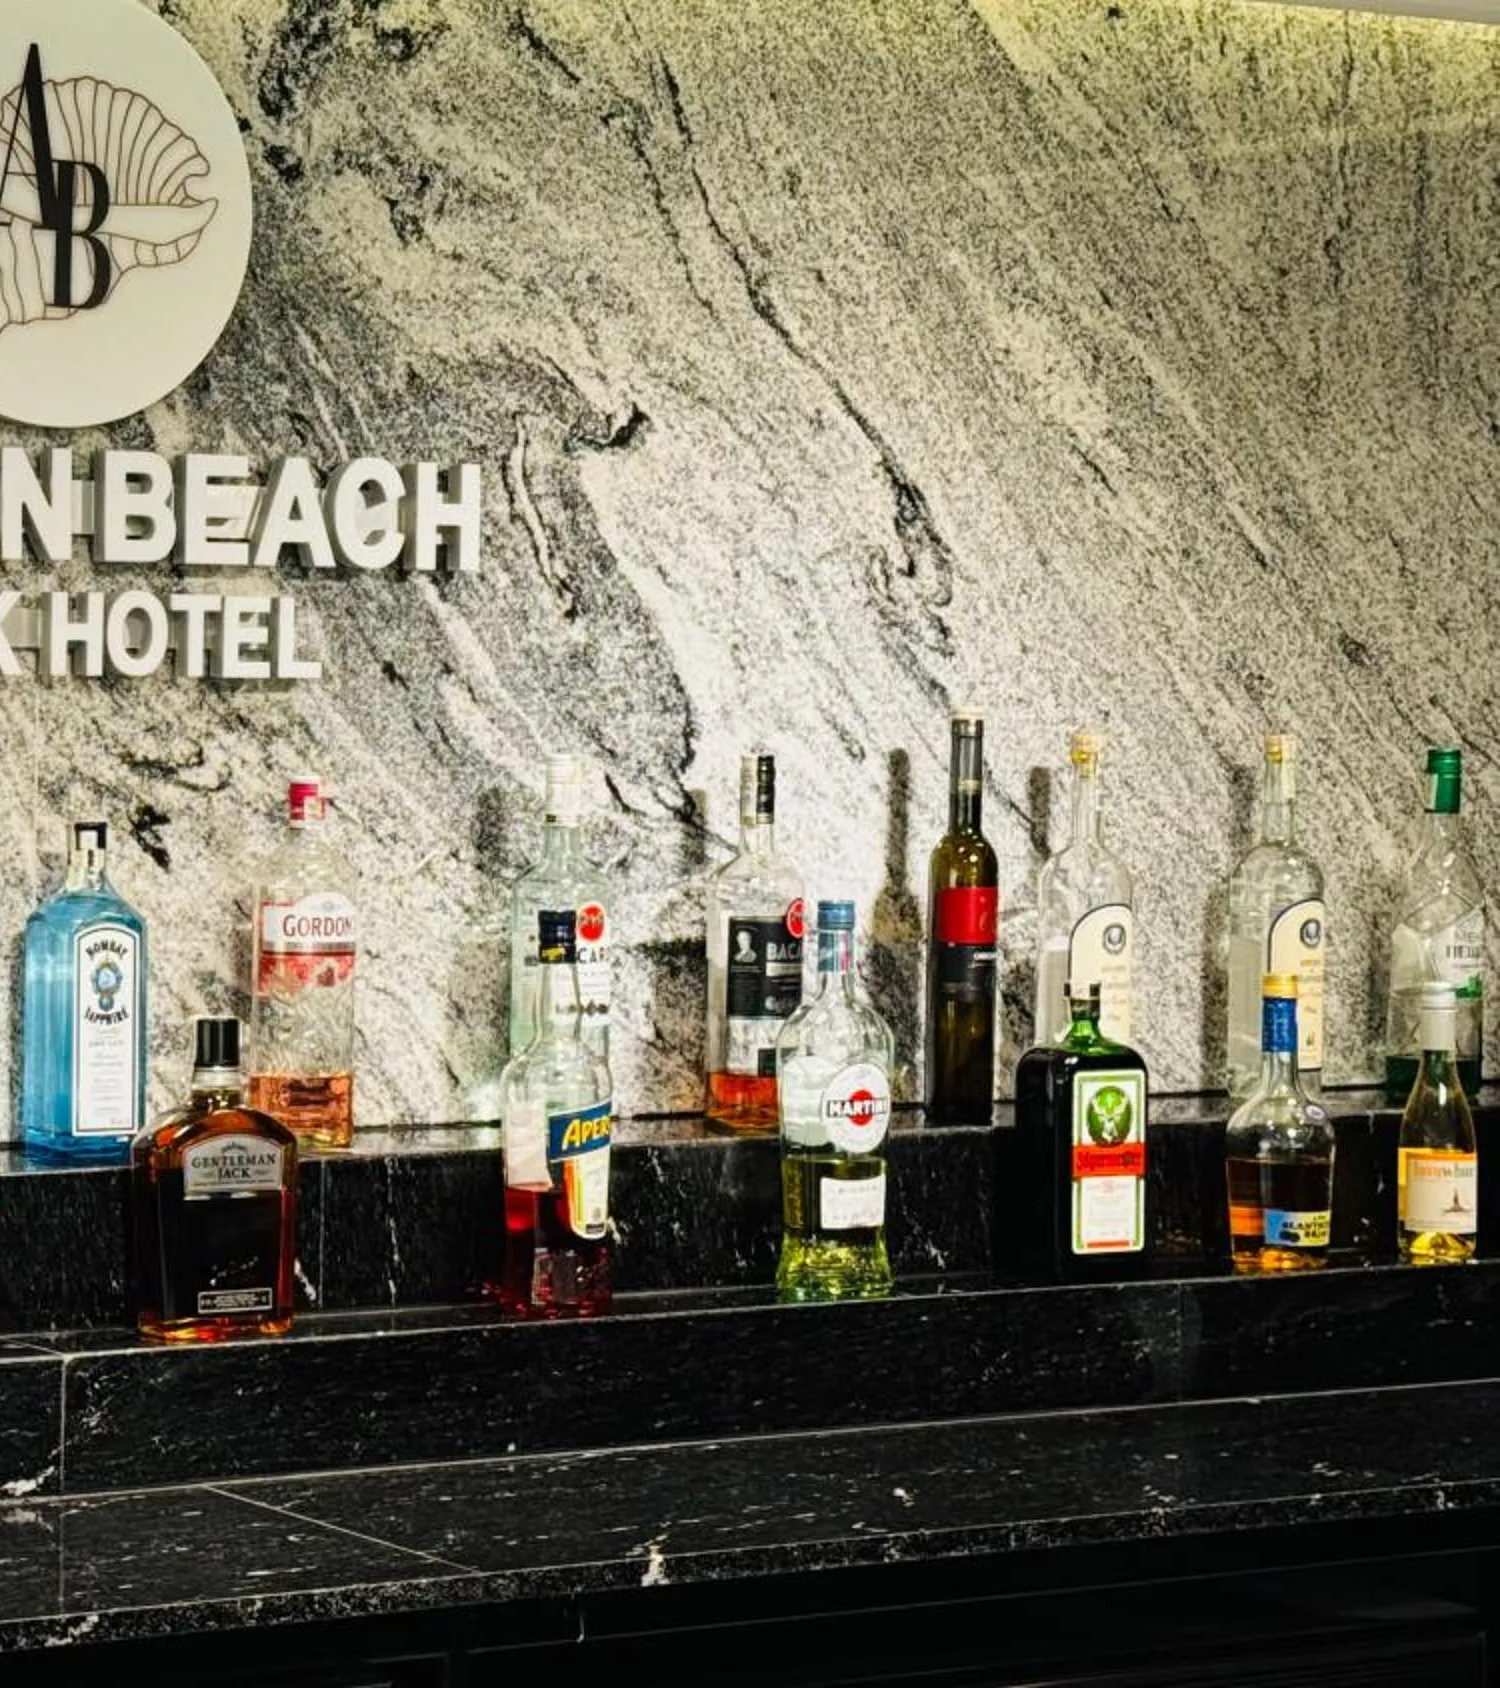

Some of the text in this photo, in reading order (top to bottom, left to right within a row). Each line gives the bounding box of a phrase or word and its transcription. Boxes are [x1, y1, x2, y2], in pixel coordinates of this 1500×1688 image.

[100, 448, 482, 573] BEACH
[49, 591, 323, 682] HOTEL
[561, 1113, 613, 1151] APER
[191, 1153, 277, 1169] GENTLEMAN
[218, 1166, 252, 1180] JACK
